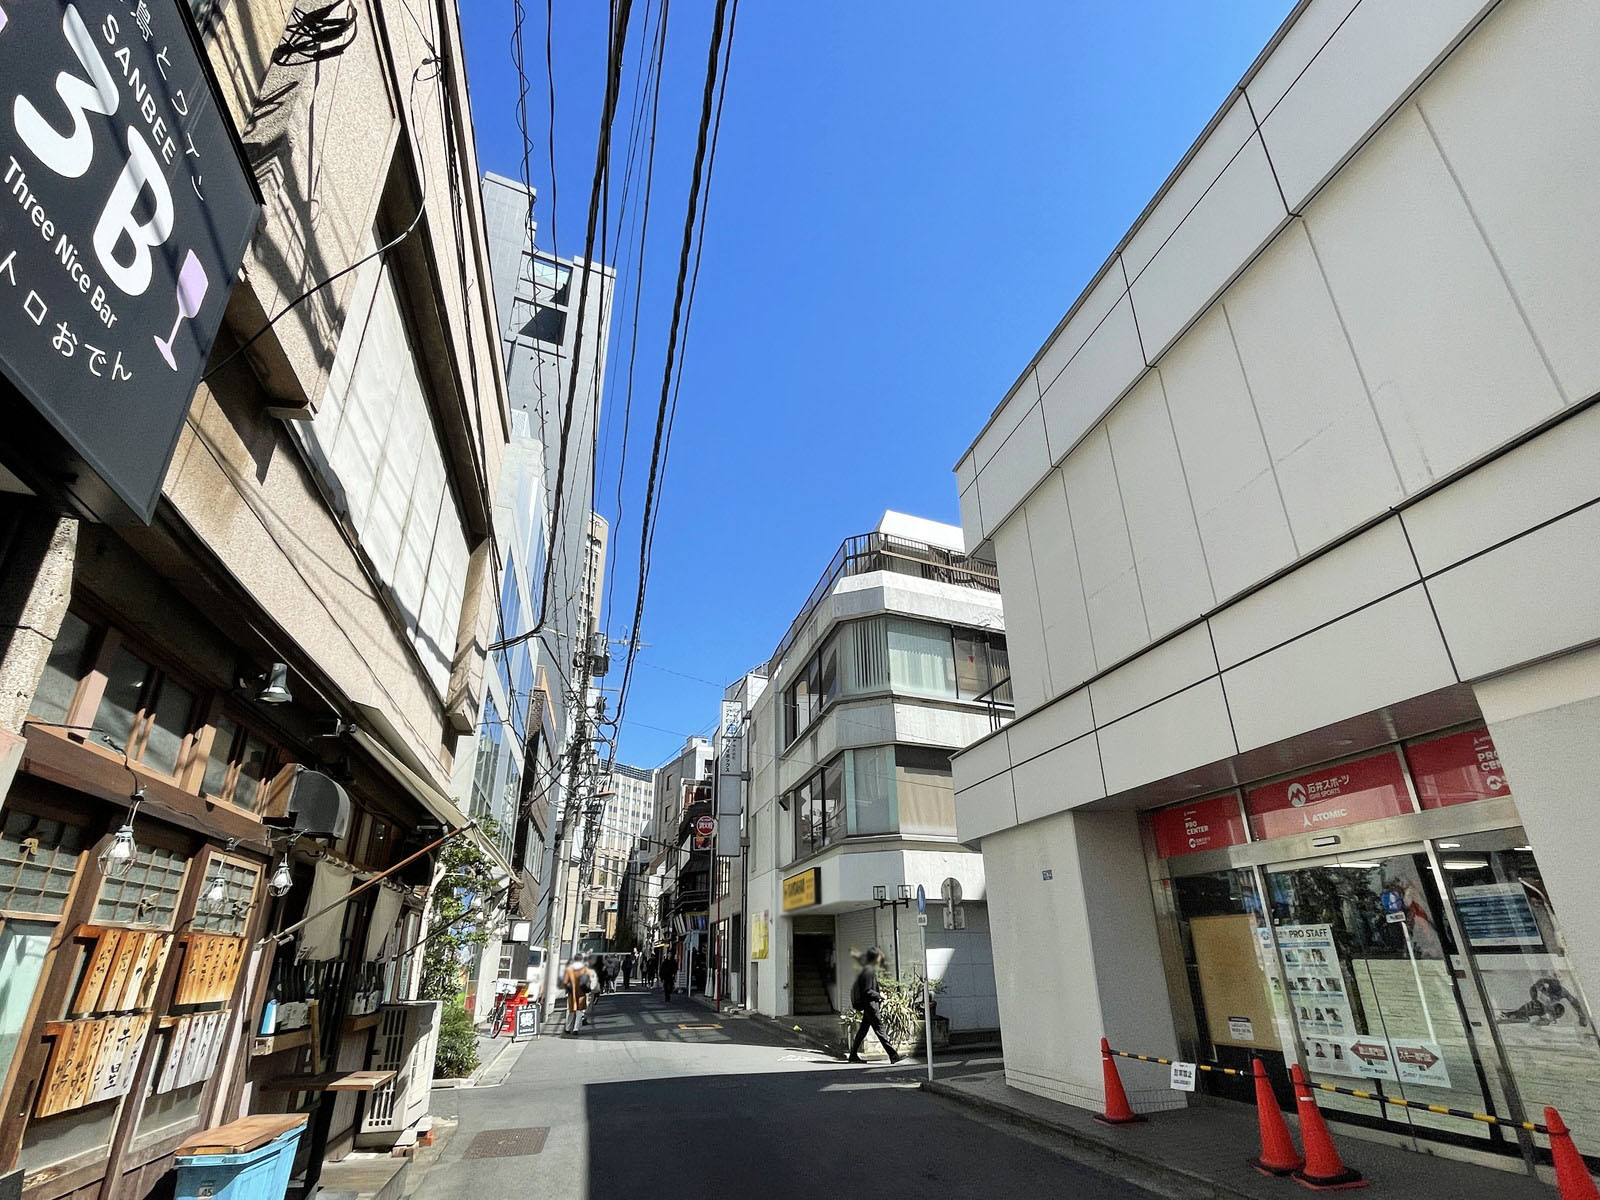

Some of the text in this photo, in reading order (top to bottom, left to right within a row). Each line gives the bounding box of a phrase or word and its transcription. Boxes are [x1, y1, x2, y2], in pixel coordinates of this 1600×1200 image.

[102, 13, 177, 165] SANBEE
[4, 155, 118, 328] Three Nice Bar
[1307, 775, 1350, 794] 石井スポーツ
[1312, 808, 1348, 823] ATOMIC
[1184, 820, 1198, 829] PRO
[1186, 825, 1209, 836] CENTER
[1288, 930, 1305, 938] PRO
[1306, 928, 1327, 938] STAFF
